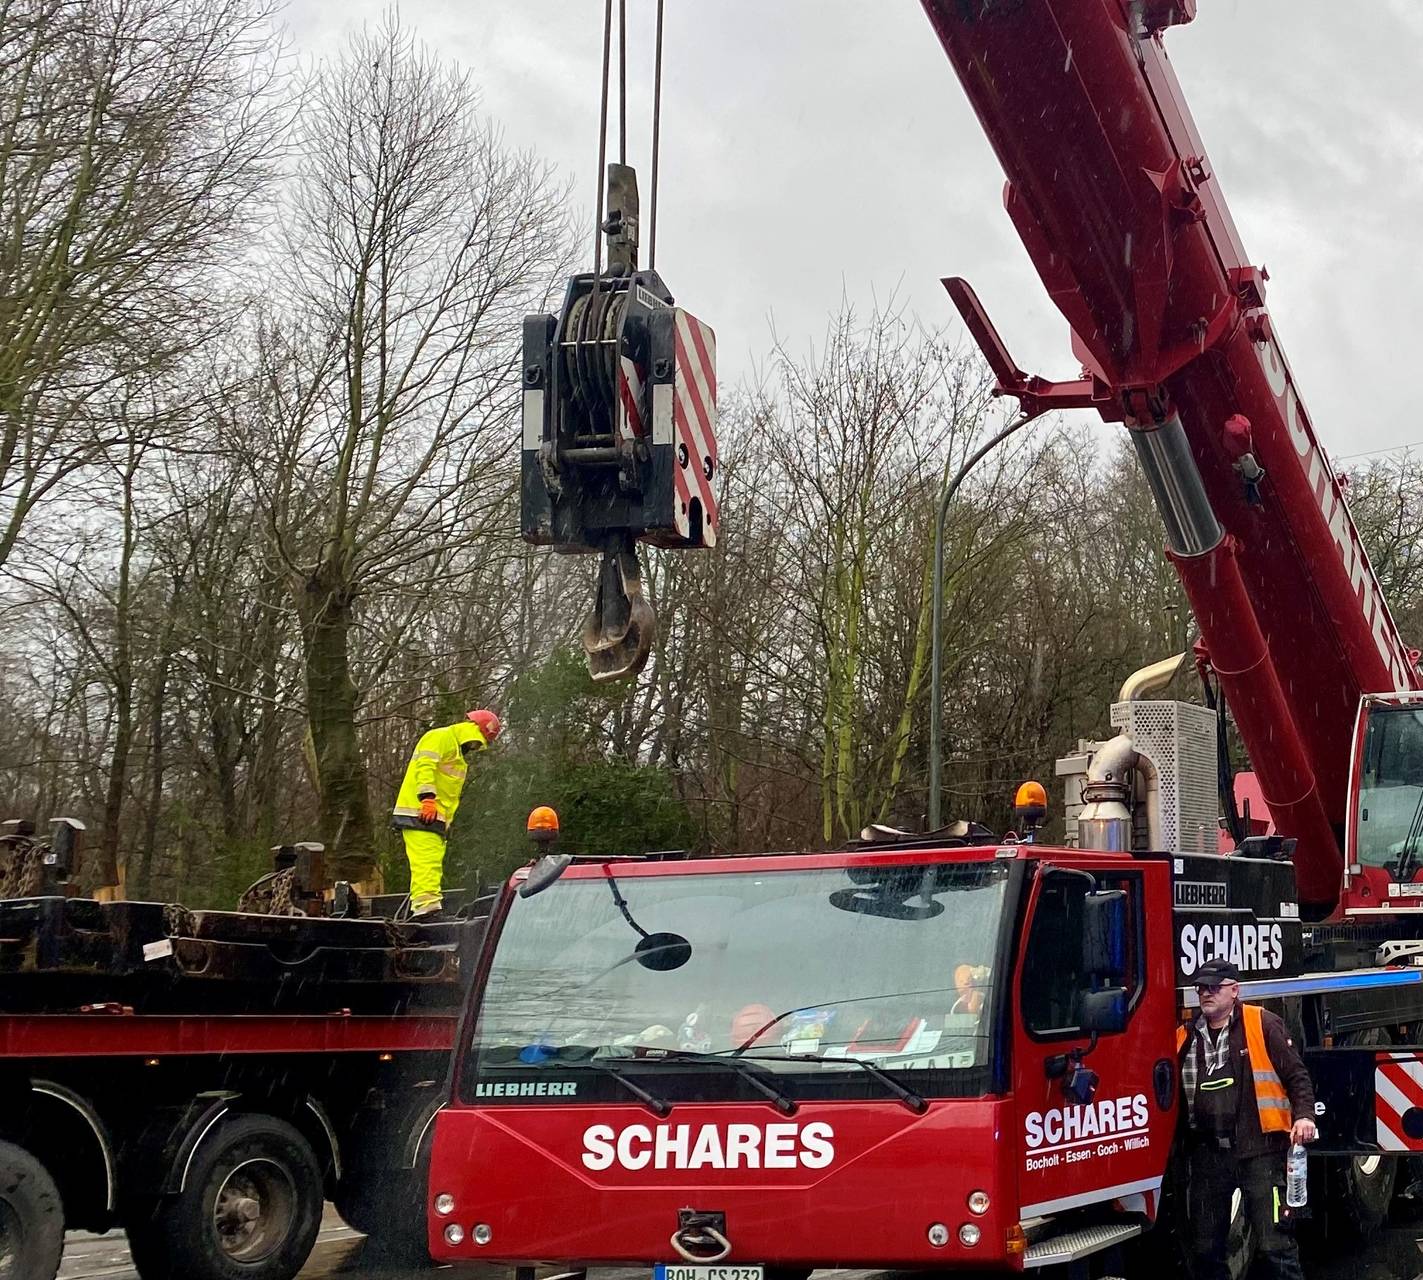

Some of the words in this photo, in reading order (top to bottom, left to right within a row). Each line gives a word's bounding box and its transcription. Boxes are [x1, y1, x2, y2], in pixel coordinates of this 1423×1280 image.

[1175, 884, 1226, 905] LIEBHERR
[1180, 923, 1283, 976] SCHARES
[476, 1082, 577, 1097] LIEBHERR
[1025, 1093, 1149, 1148] SCHARES
[581, 1122, 835, 1171] SCHARES
[1026, 1153, 1060, 1171] Bocholt
[1066, 1150, 1091, 1163] Essen
[1097, 1142, 1119, 1157] Goch
[1124, 1136, 1150, 1151] Willich
